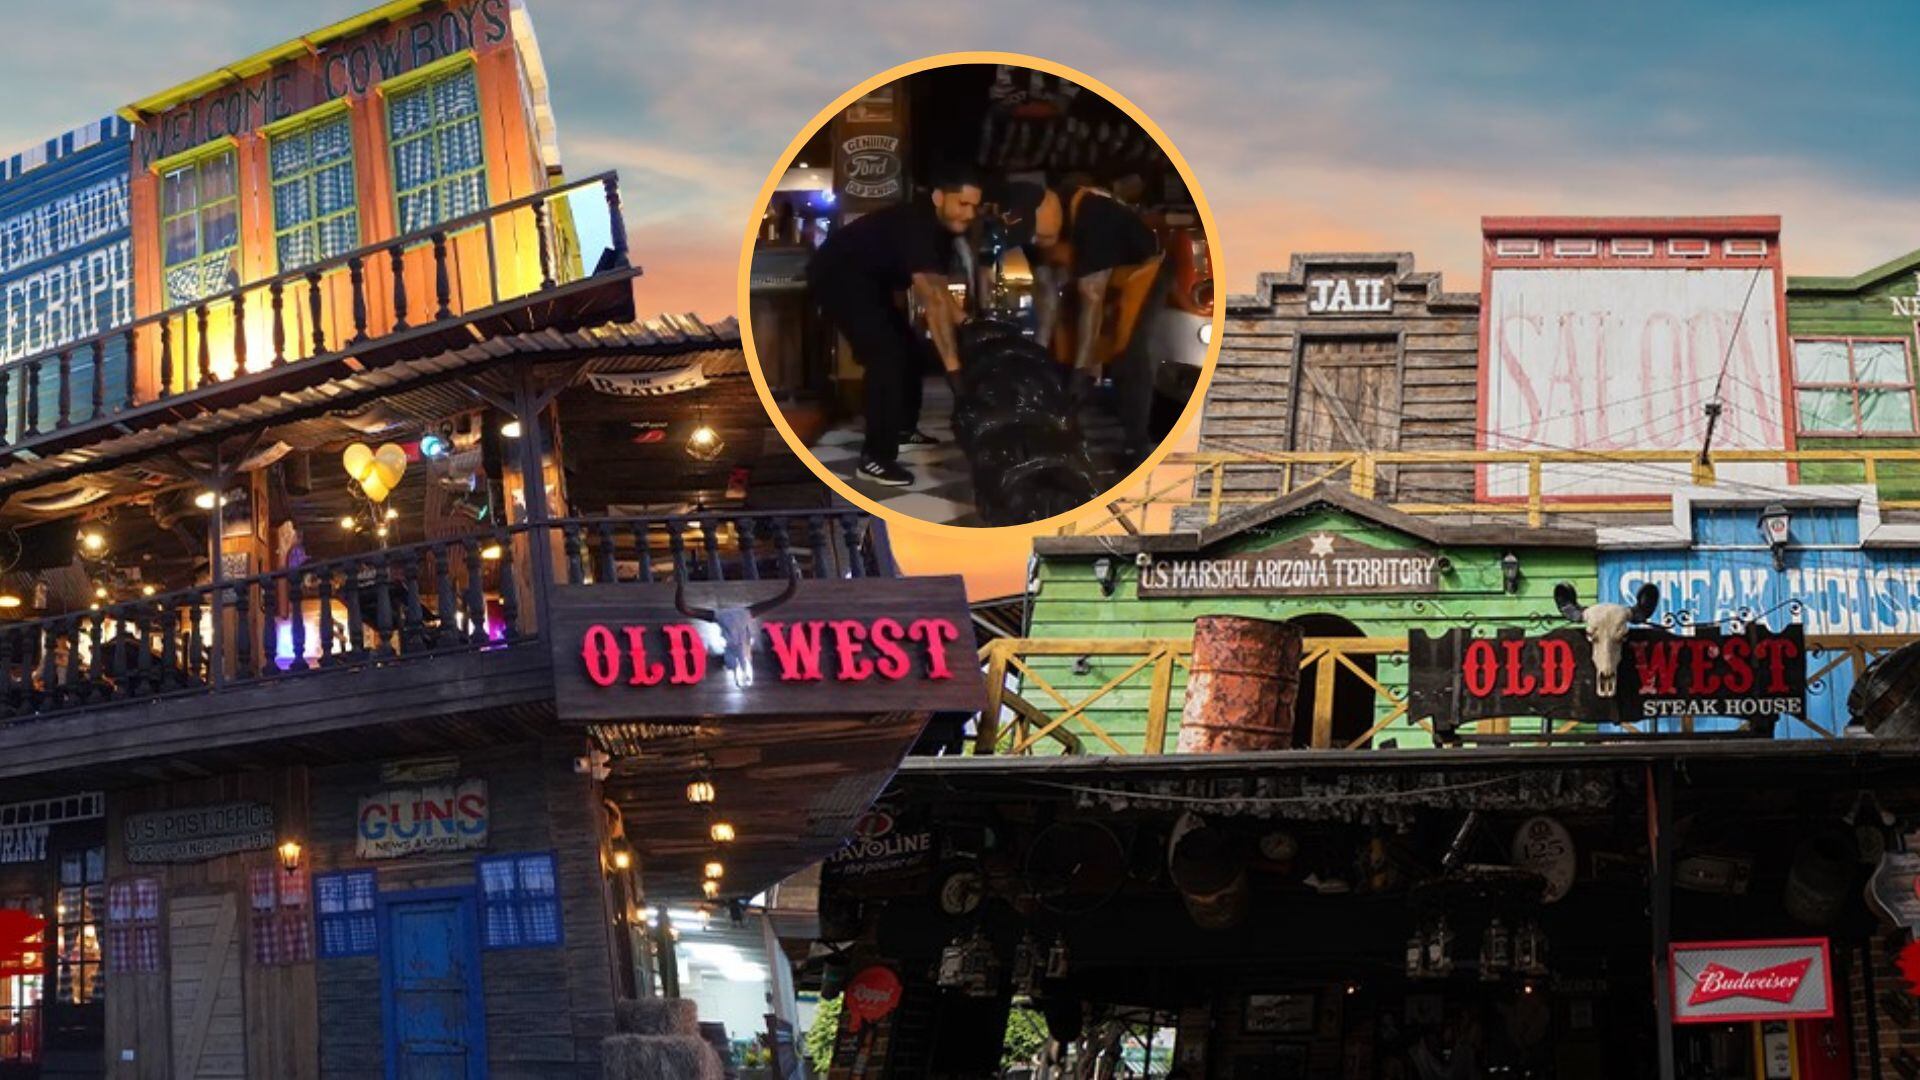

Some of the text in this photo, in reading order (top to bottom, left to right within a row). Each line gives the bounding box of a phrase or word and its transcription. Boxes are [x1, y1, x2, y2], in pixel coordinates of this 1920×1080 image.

[138, 0, 507, 173] WELCOME COWBOYS
[850, 155, 889, 177] Ford
[56, 174, 129, 252] UNION
[0, 237, 132, 365] EGRAPH
[1310, 279, 1391, 312] JAIL
[1496, 310, 1785, 450] SALOON
[1172, 558, 1250, 588] MARSHAL
[1253, 556, 1329, 588] ARIZONA
[1332, 556, 1437, 586] TERRITORY
[582, 618, 960, 687] OLD WEST
[1462, 637, 1799, 697] OLD WEST
[1643, 697, 1802, 717] STEAK HOUSE
[164, 812, 208, 834] POST
[215, 803, 275, 830] OFFICE
[360, 795, 487, 840] GUNS
[1697, 971, 1799, 992] Budweiser
